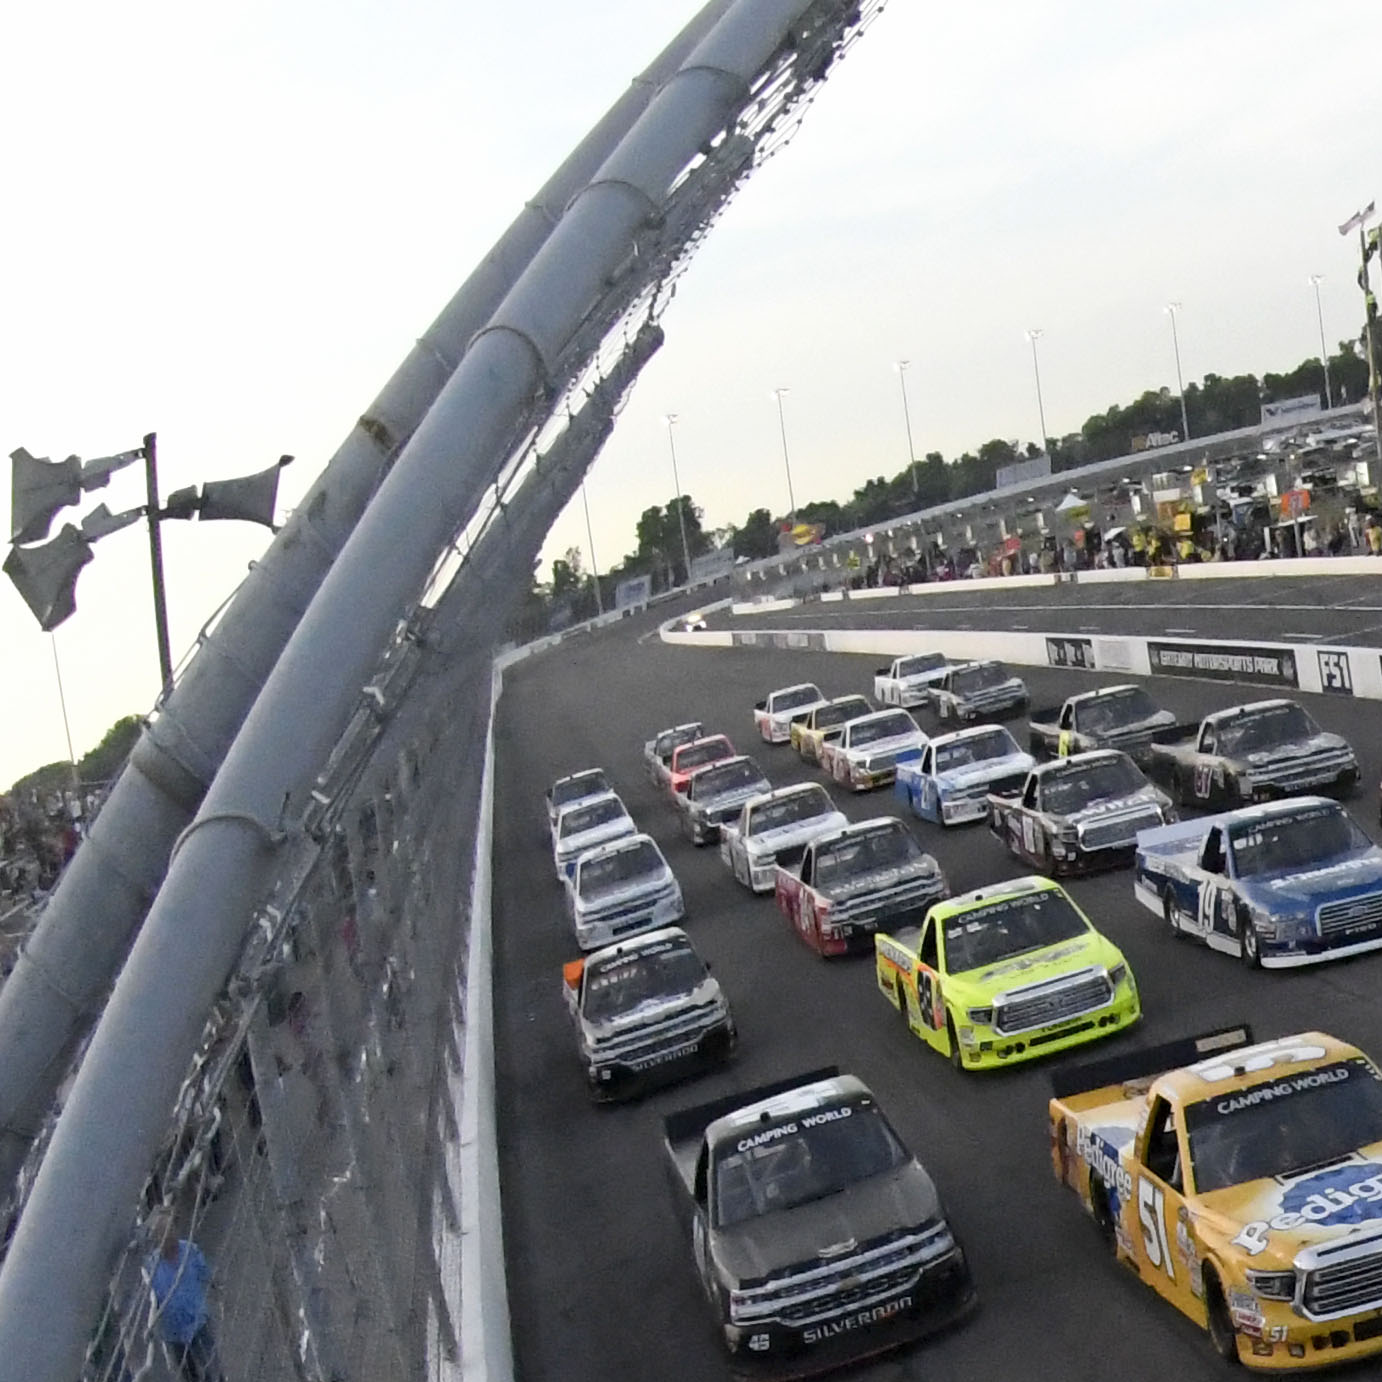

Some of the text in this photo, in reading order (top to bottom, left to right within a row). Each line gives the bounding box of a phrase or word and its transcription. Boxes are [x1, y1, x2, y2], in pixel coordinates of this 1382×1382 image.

[1320, 653, 1350, 688] FS1
[1217, 1068, 1349, 1115] CAMPING WORLD
[737, 1107, 852, 1152] CAMPING WORLD
[1138, 1175, 1175, 1281] 51
[1269, 1325, 1289, 1343] 51
